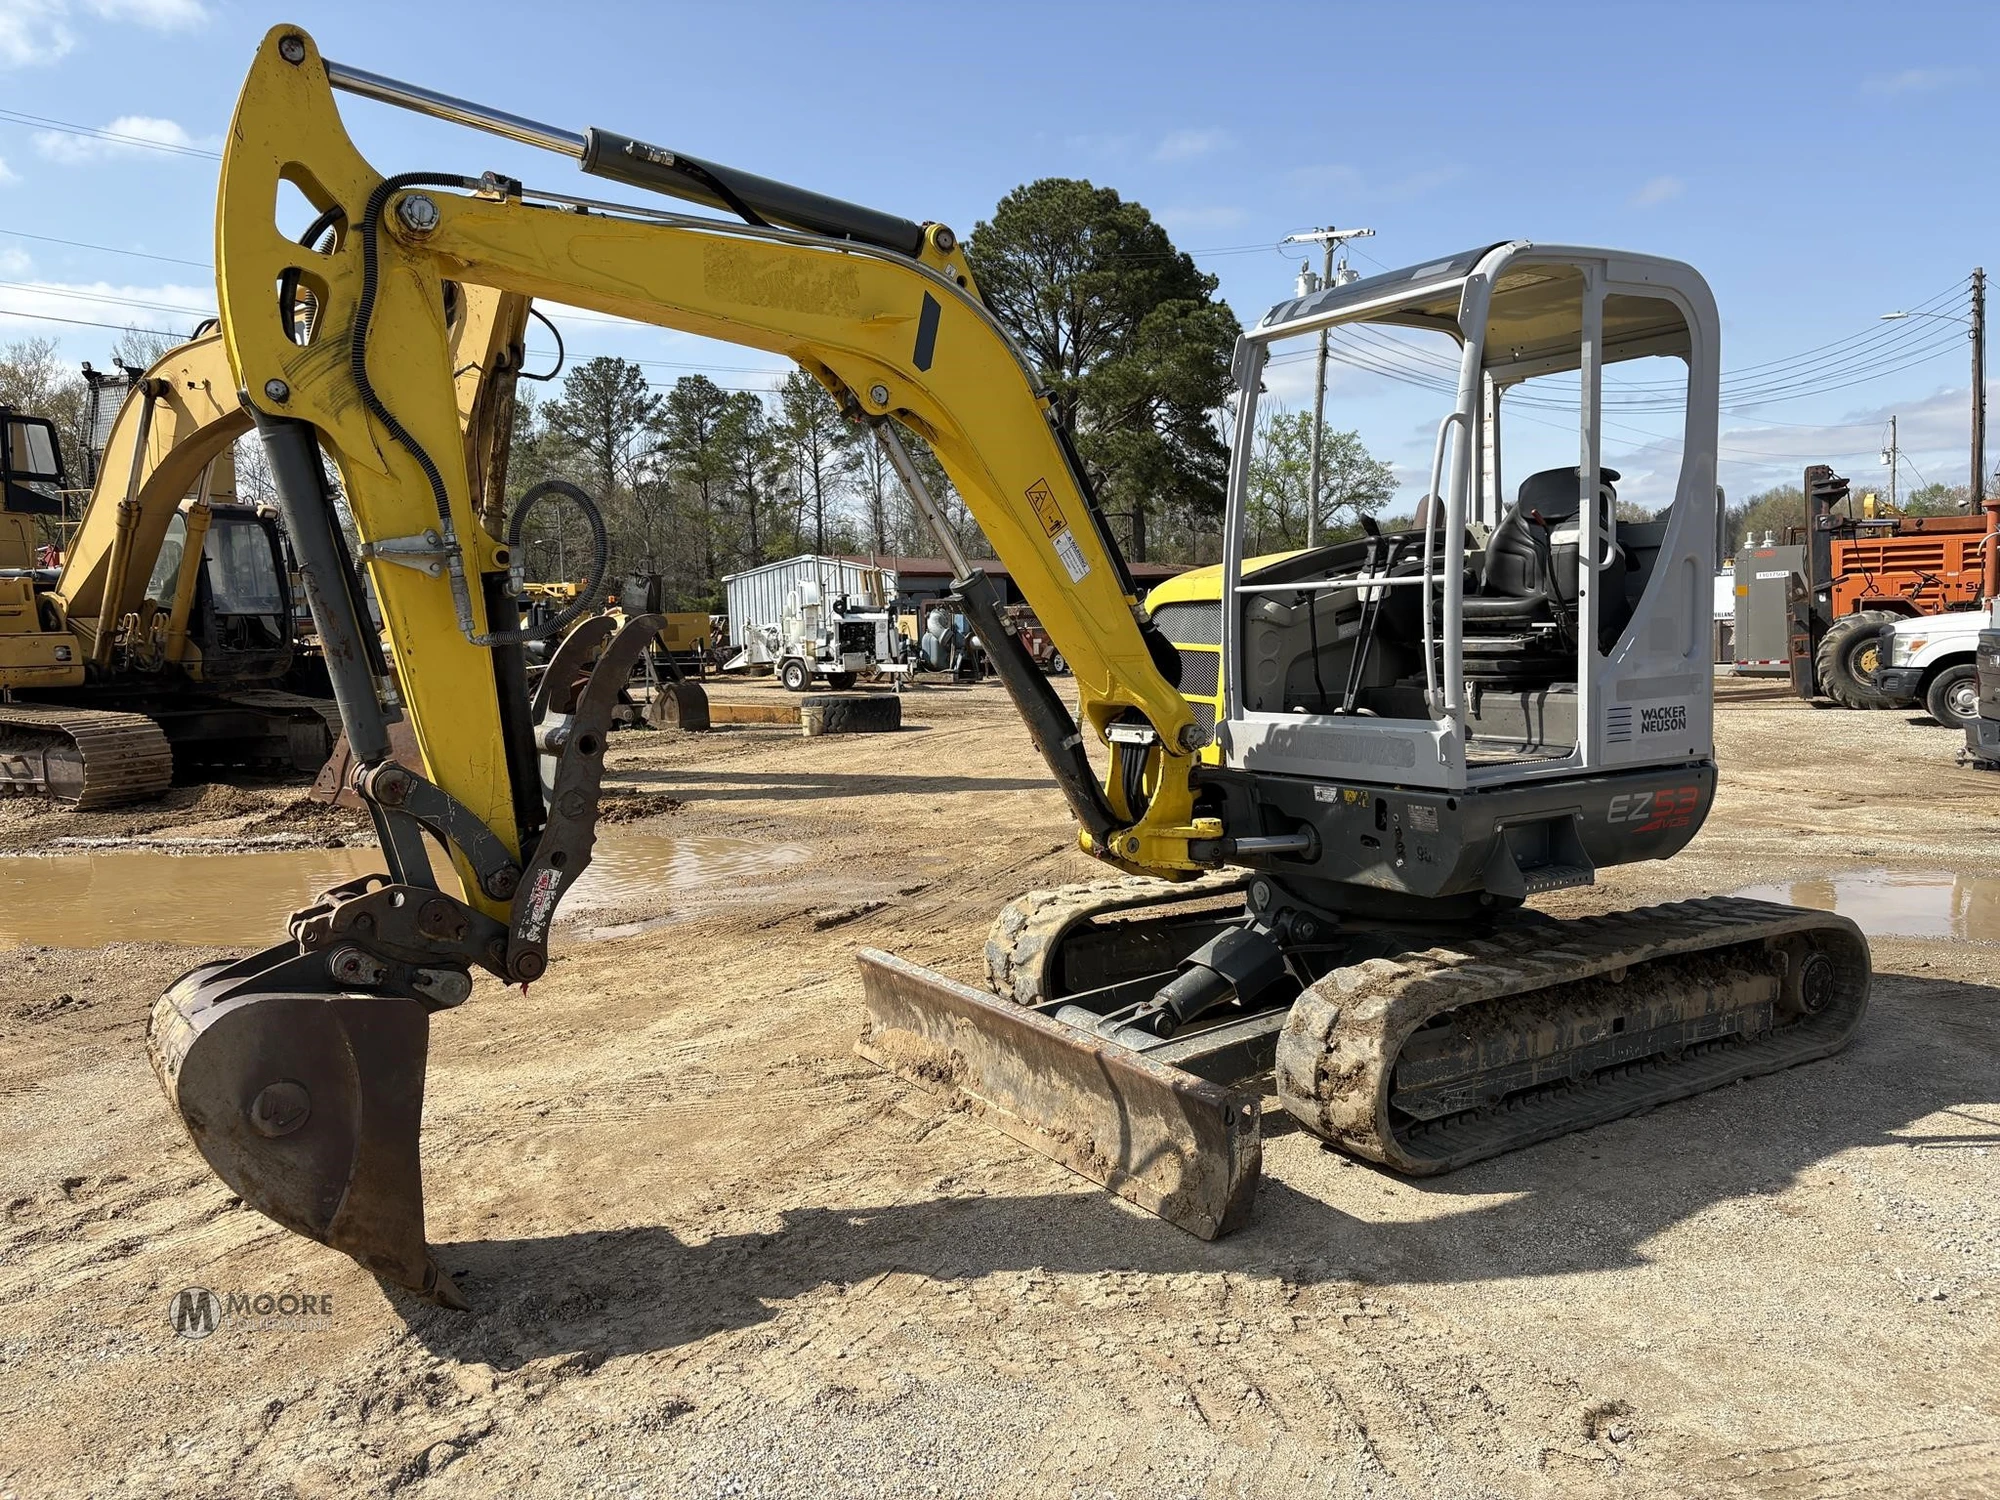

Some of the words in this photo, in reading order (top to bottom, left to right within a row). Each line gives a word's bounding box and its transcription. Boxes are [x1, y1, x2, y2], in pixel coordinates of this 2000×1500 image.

[1641, 705, 1686, 721] WACKER
[1641, 717, 1686, 734] NEUSON
[1607, 786, 1698, 823] EZ53
